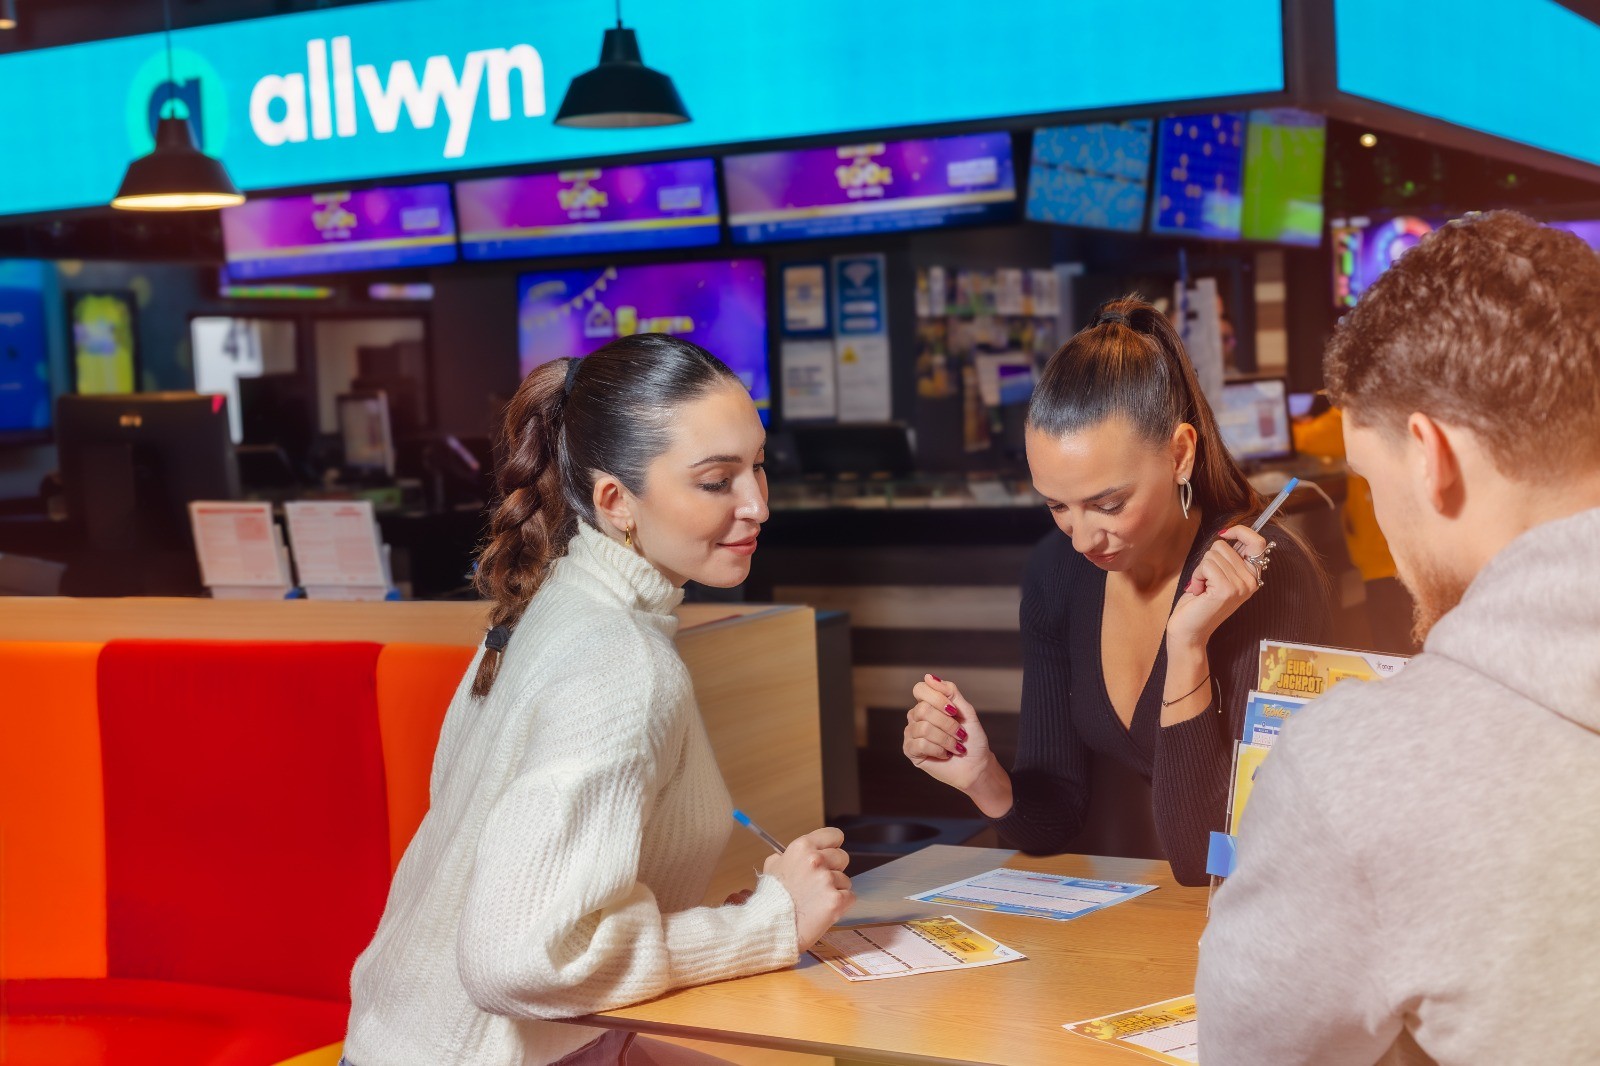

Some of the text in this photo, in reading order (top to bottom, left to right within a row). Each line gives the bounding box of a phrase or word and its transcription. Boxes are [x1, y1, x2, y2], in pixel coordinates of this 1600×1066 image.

[249, 36, 546, 158] allwyn
[1286, 659, 1313, 676] EURO
[1277, 673, 1323, 694] JACKPOT
